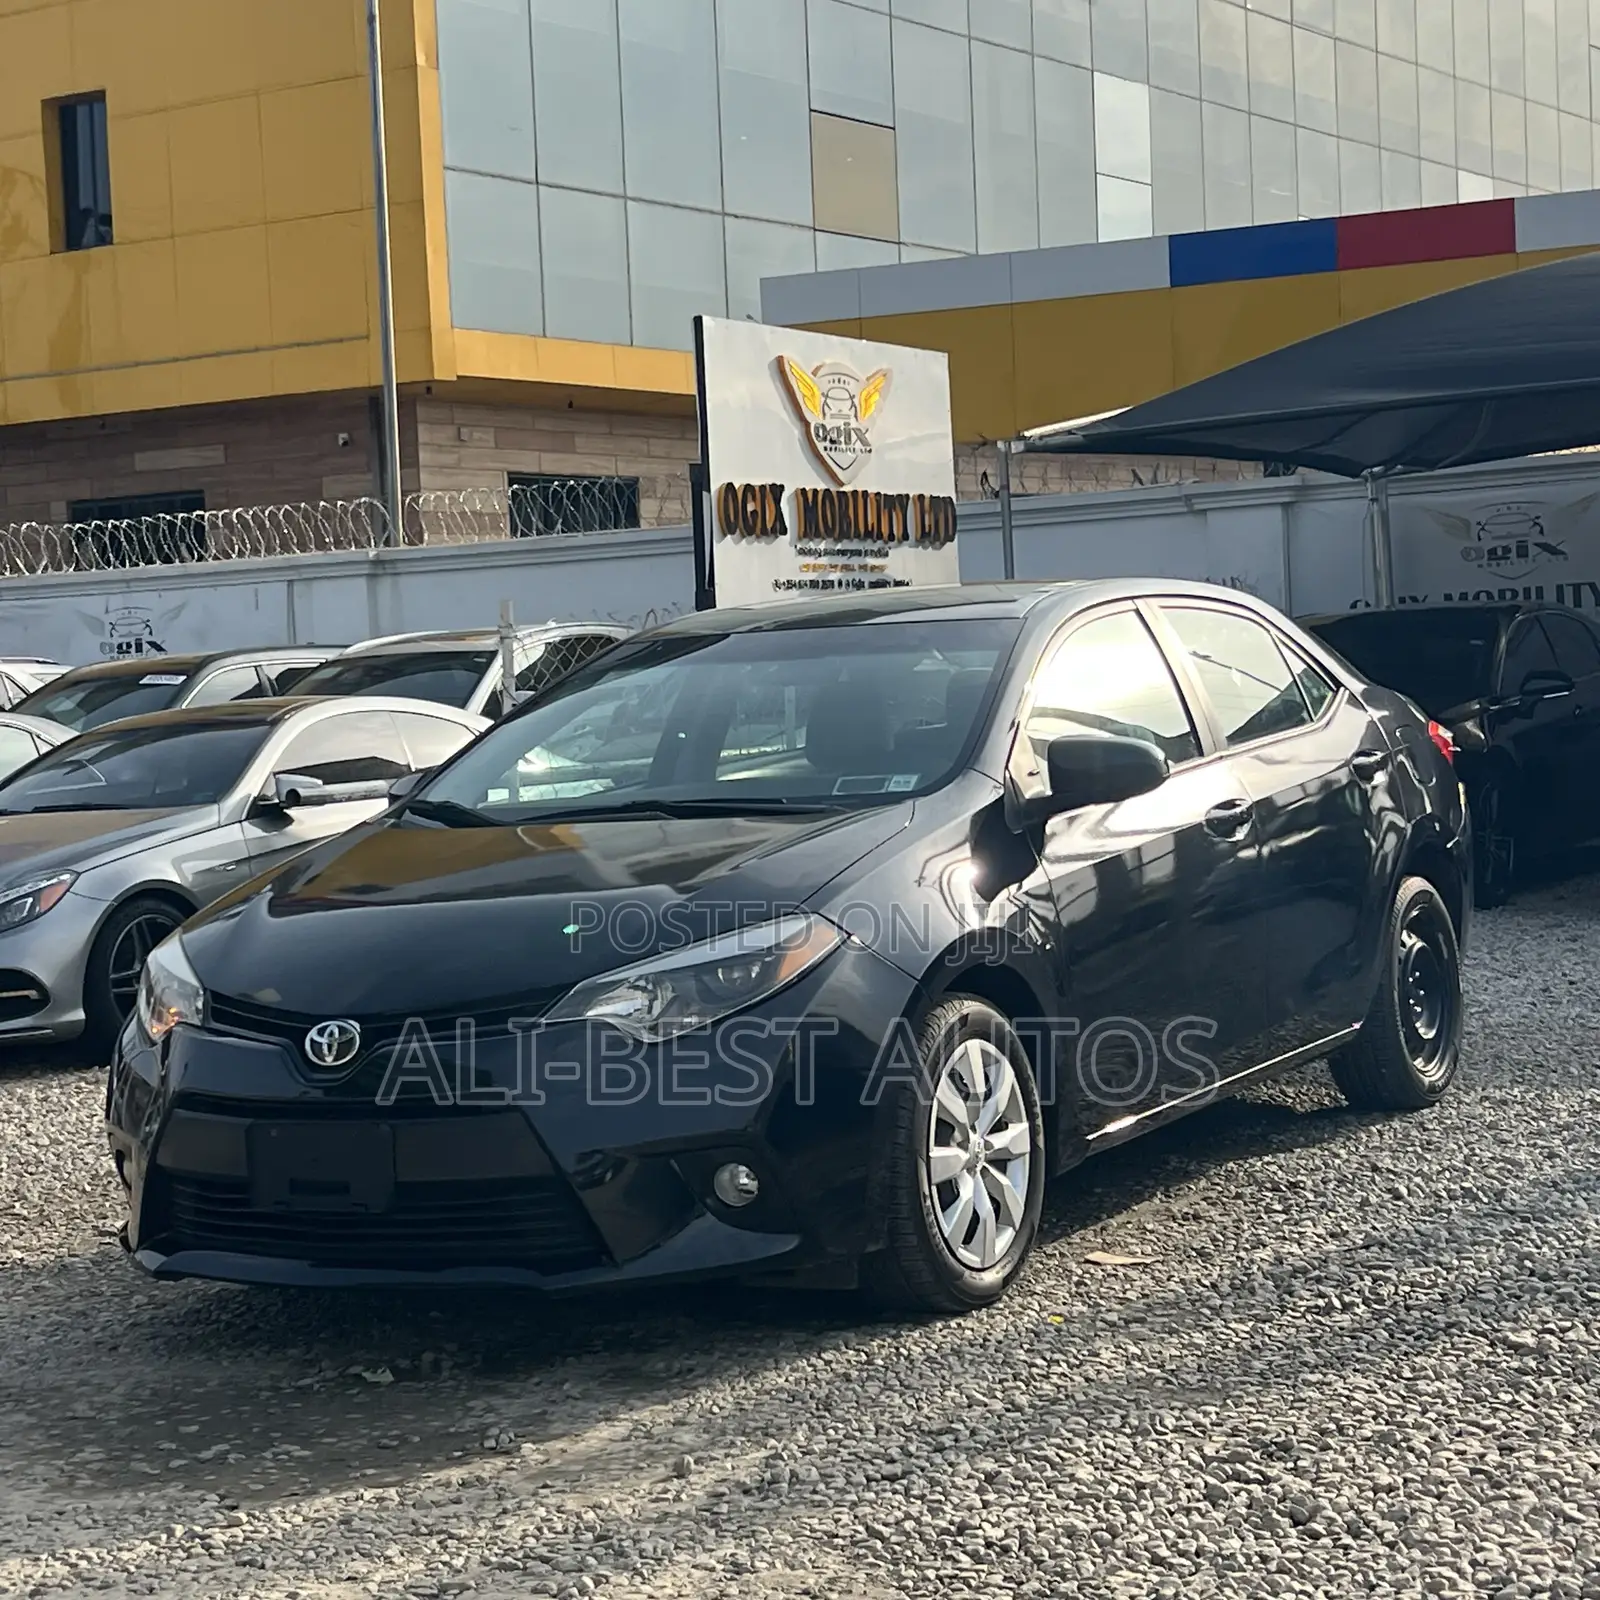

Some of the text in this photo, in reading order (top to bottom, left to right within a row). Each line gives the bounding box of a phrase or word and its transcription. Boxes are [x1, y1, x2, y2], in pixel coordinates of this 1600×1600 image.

[718, 482, 958, 543] OGIX MOBILITY LTD
